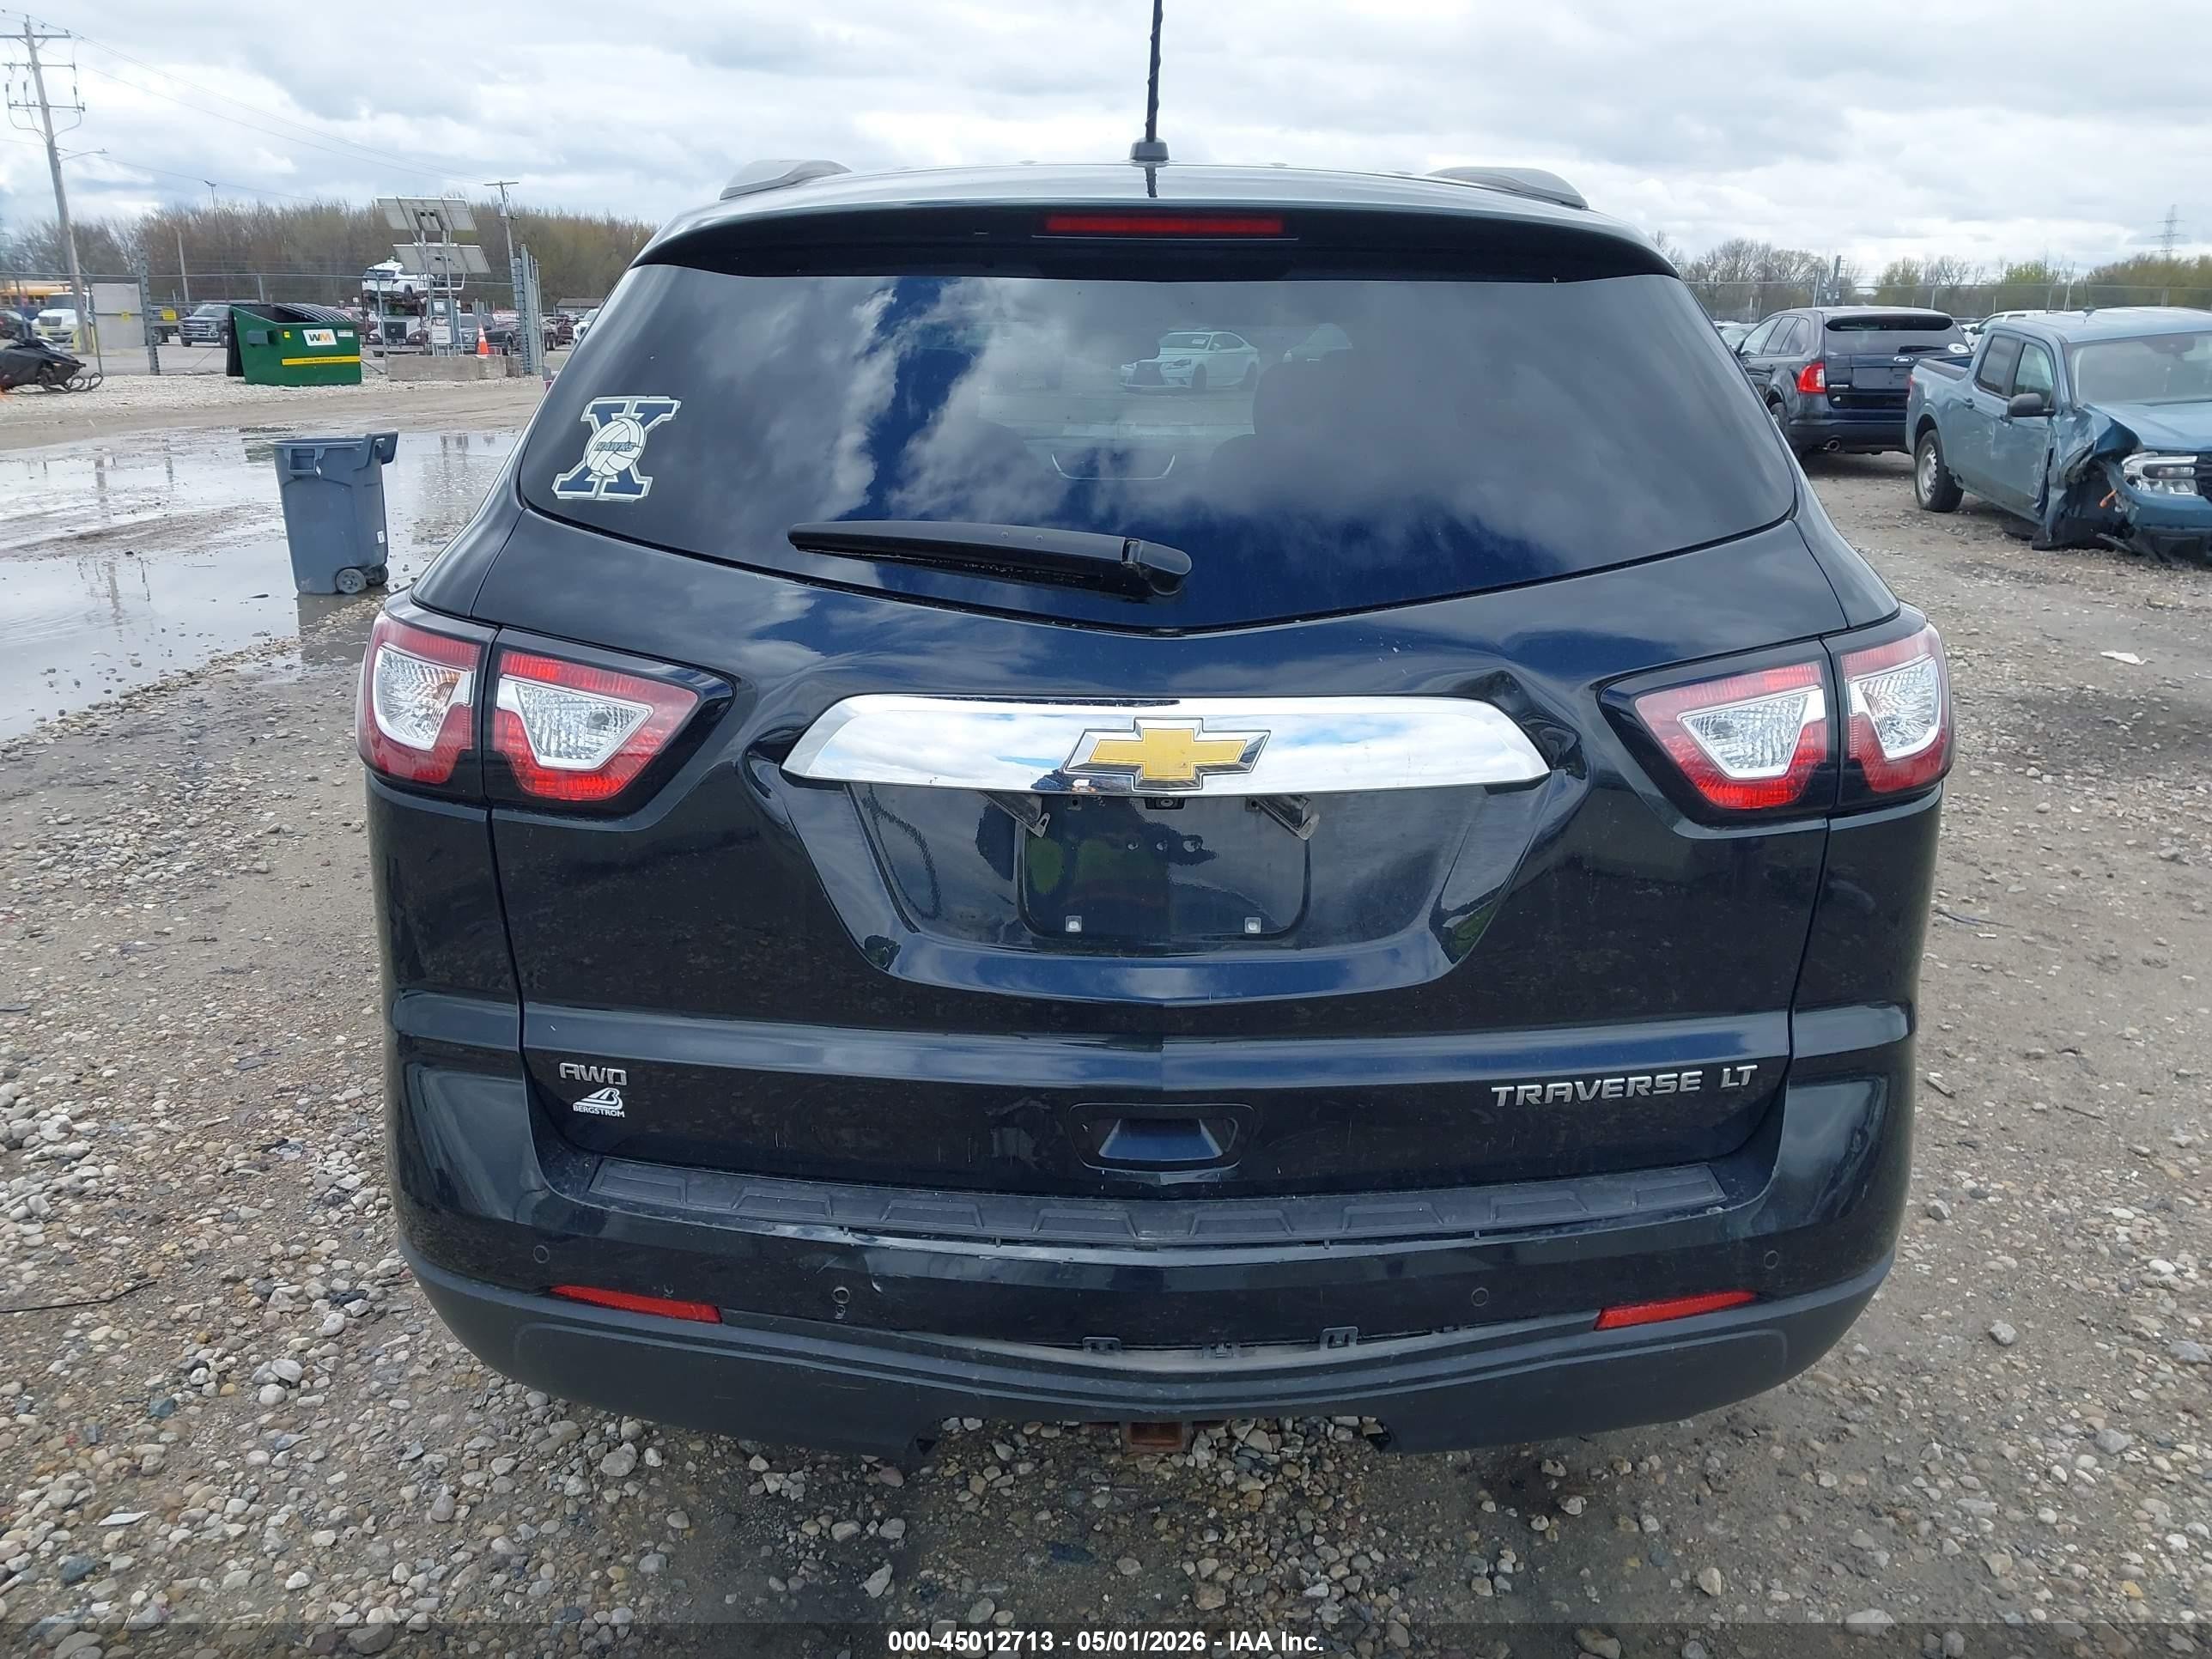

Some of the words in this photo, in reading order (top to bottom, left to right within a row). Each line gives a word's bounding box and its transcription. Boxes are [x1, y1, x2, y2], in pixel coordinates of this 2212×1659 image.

[308, 333, 331, 342] WM
[593, 441, 636, 452] HAWKS
[559, 1062, 627, 1086] AWD
[1491, 1071, 1703, 1107] TRAVERSE
[1720, 1064, 1758, 1088] LT
[573, 1104, 625, 1117] BERGSTROM
